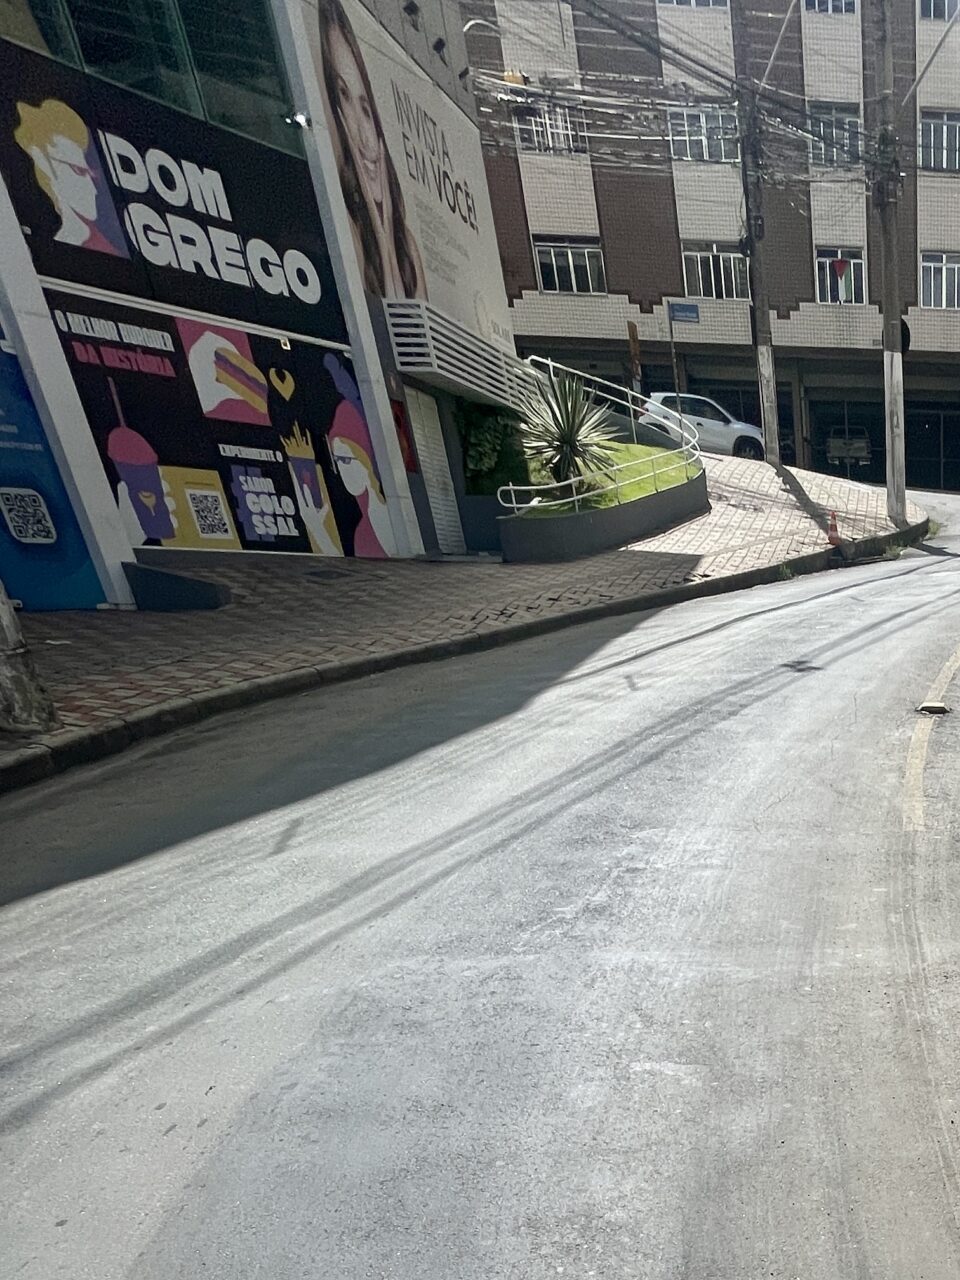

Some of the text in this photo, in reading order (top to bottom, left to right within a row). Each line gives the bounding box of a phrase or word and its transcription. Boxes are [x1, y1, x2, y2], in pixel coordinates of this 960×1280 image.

[391, 78, 453, 172] INVISTA
[97, 128, 232, 221] DOM
[402, 131, 479, 235] EM VOCÊ!
[124, 202, 321, 305] GREGO
[252, 514, 300, 537] SSAL
